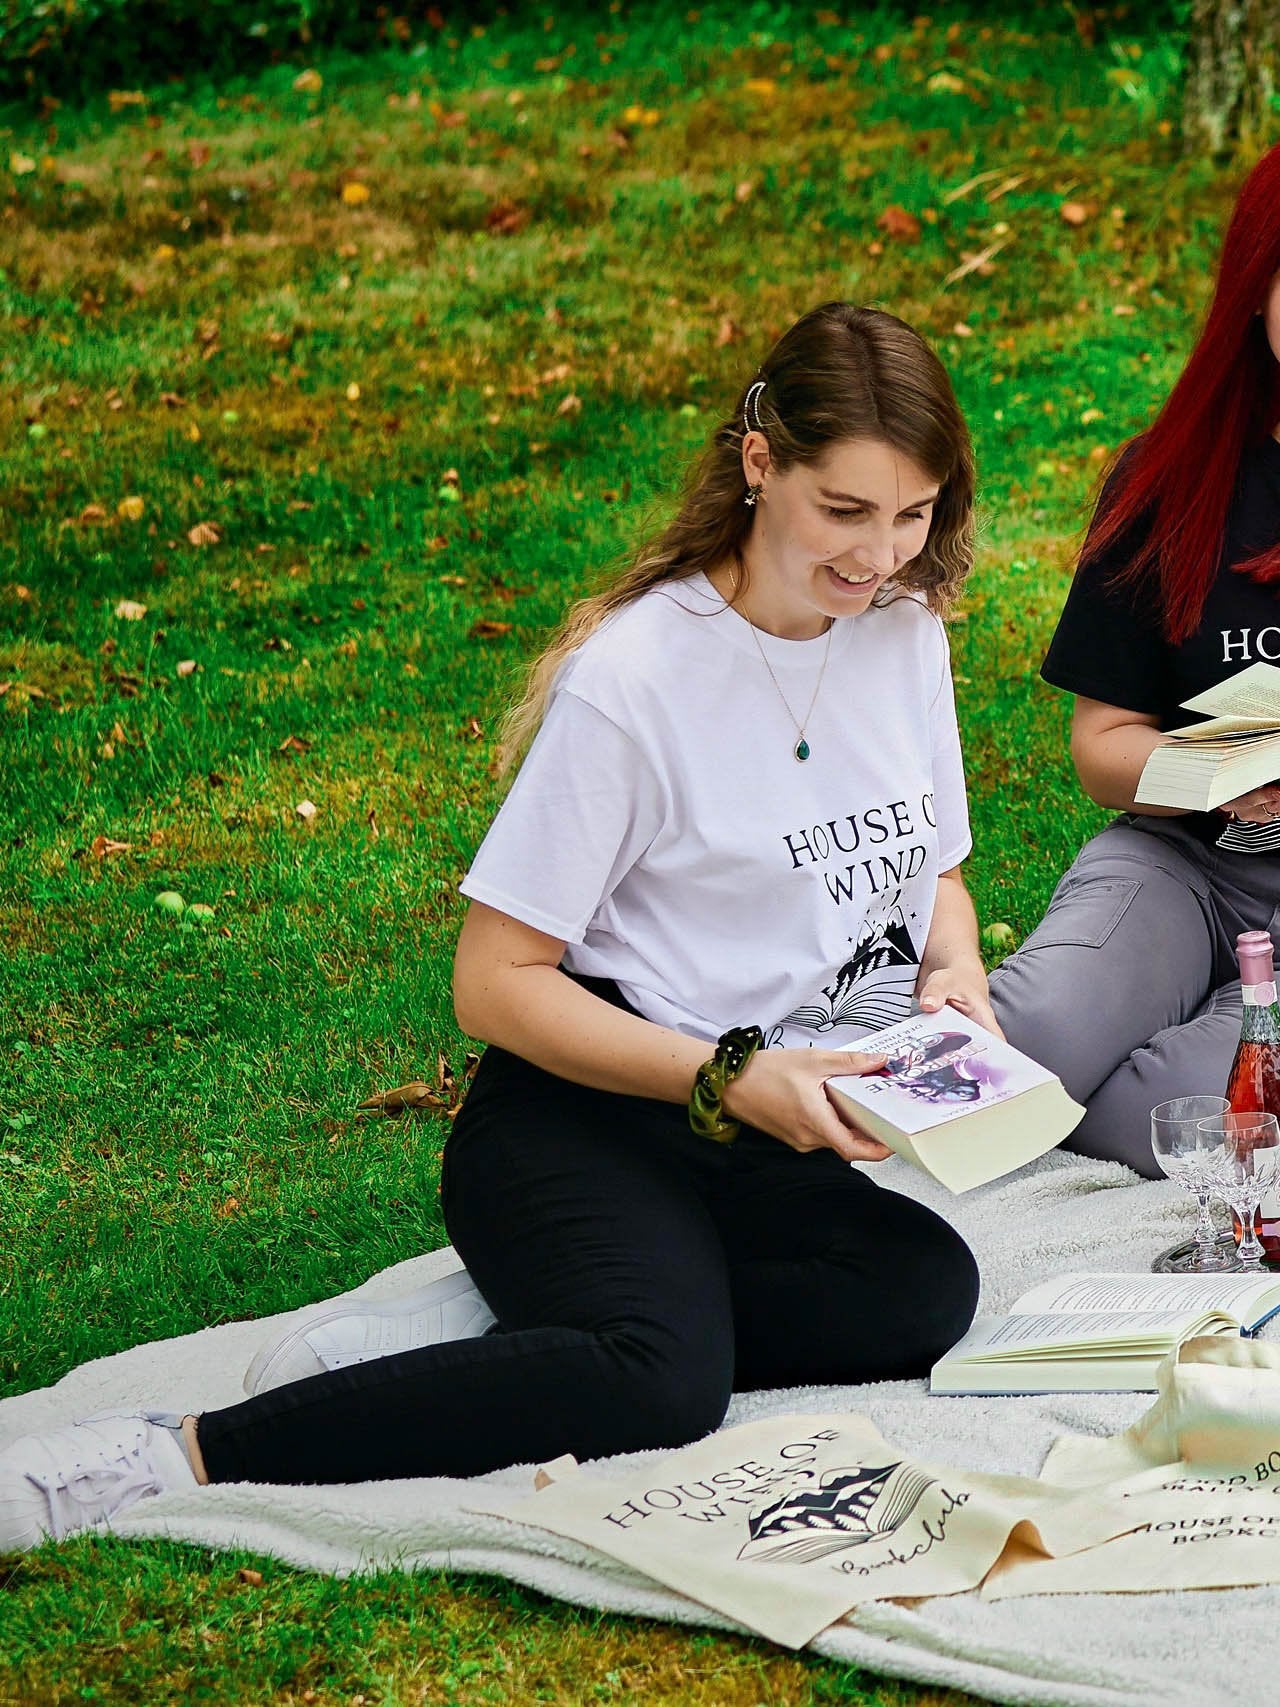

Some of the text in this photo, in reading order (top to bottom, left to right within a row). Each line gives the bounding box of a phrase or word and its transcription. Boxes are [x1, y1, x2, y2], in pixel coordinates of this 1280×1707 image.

[782, 794, 937, 869] HOUSE O
[824, 845, 926, 905] WIND
[602, 1429, 841, 1529] HOUSE OF
[1243, 1516, 1280, 1524] OF
